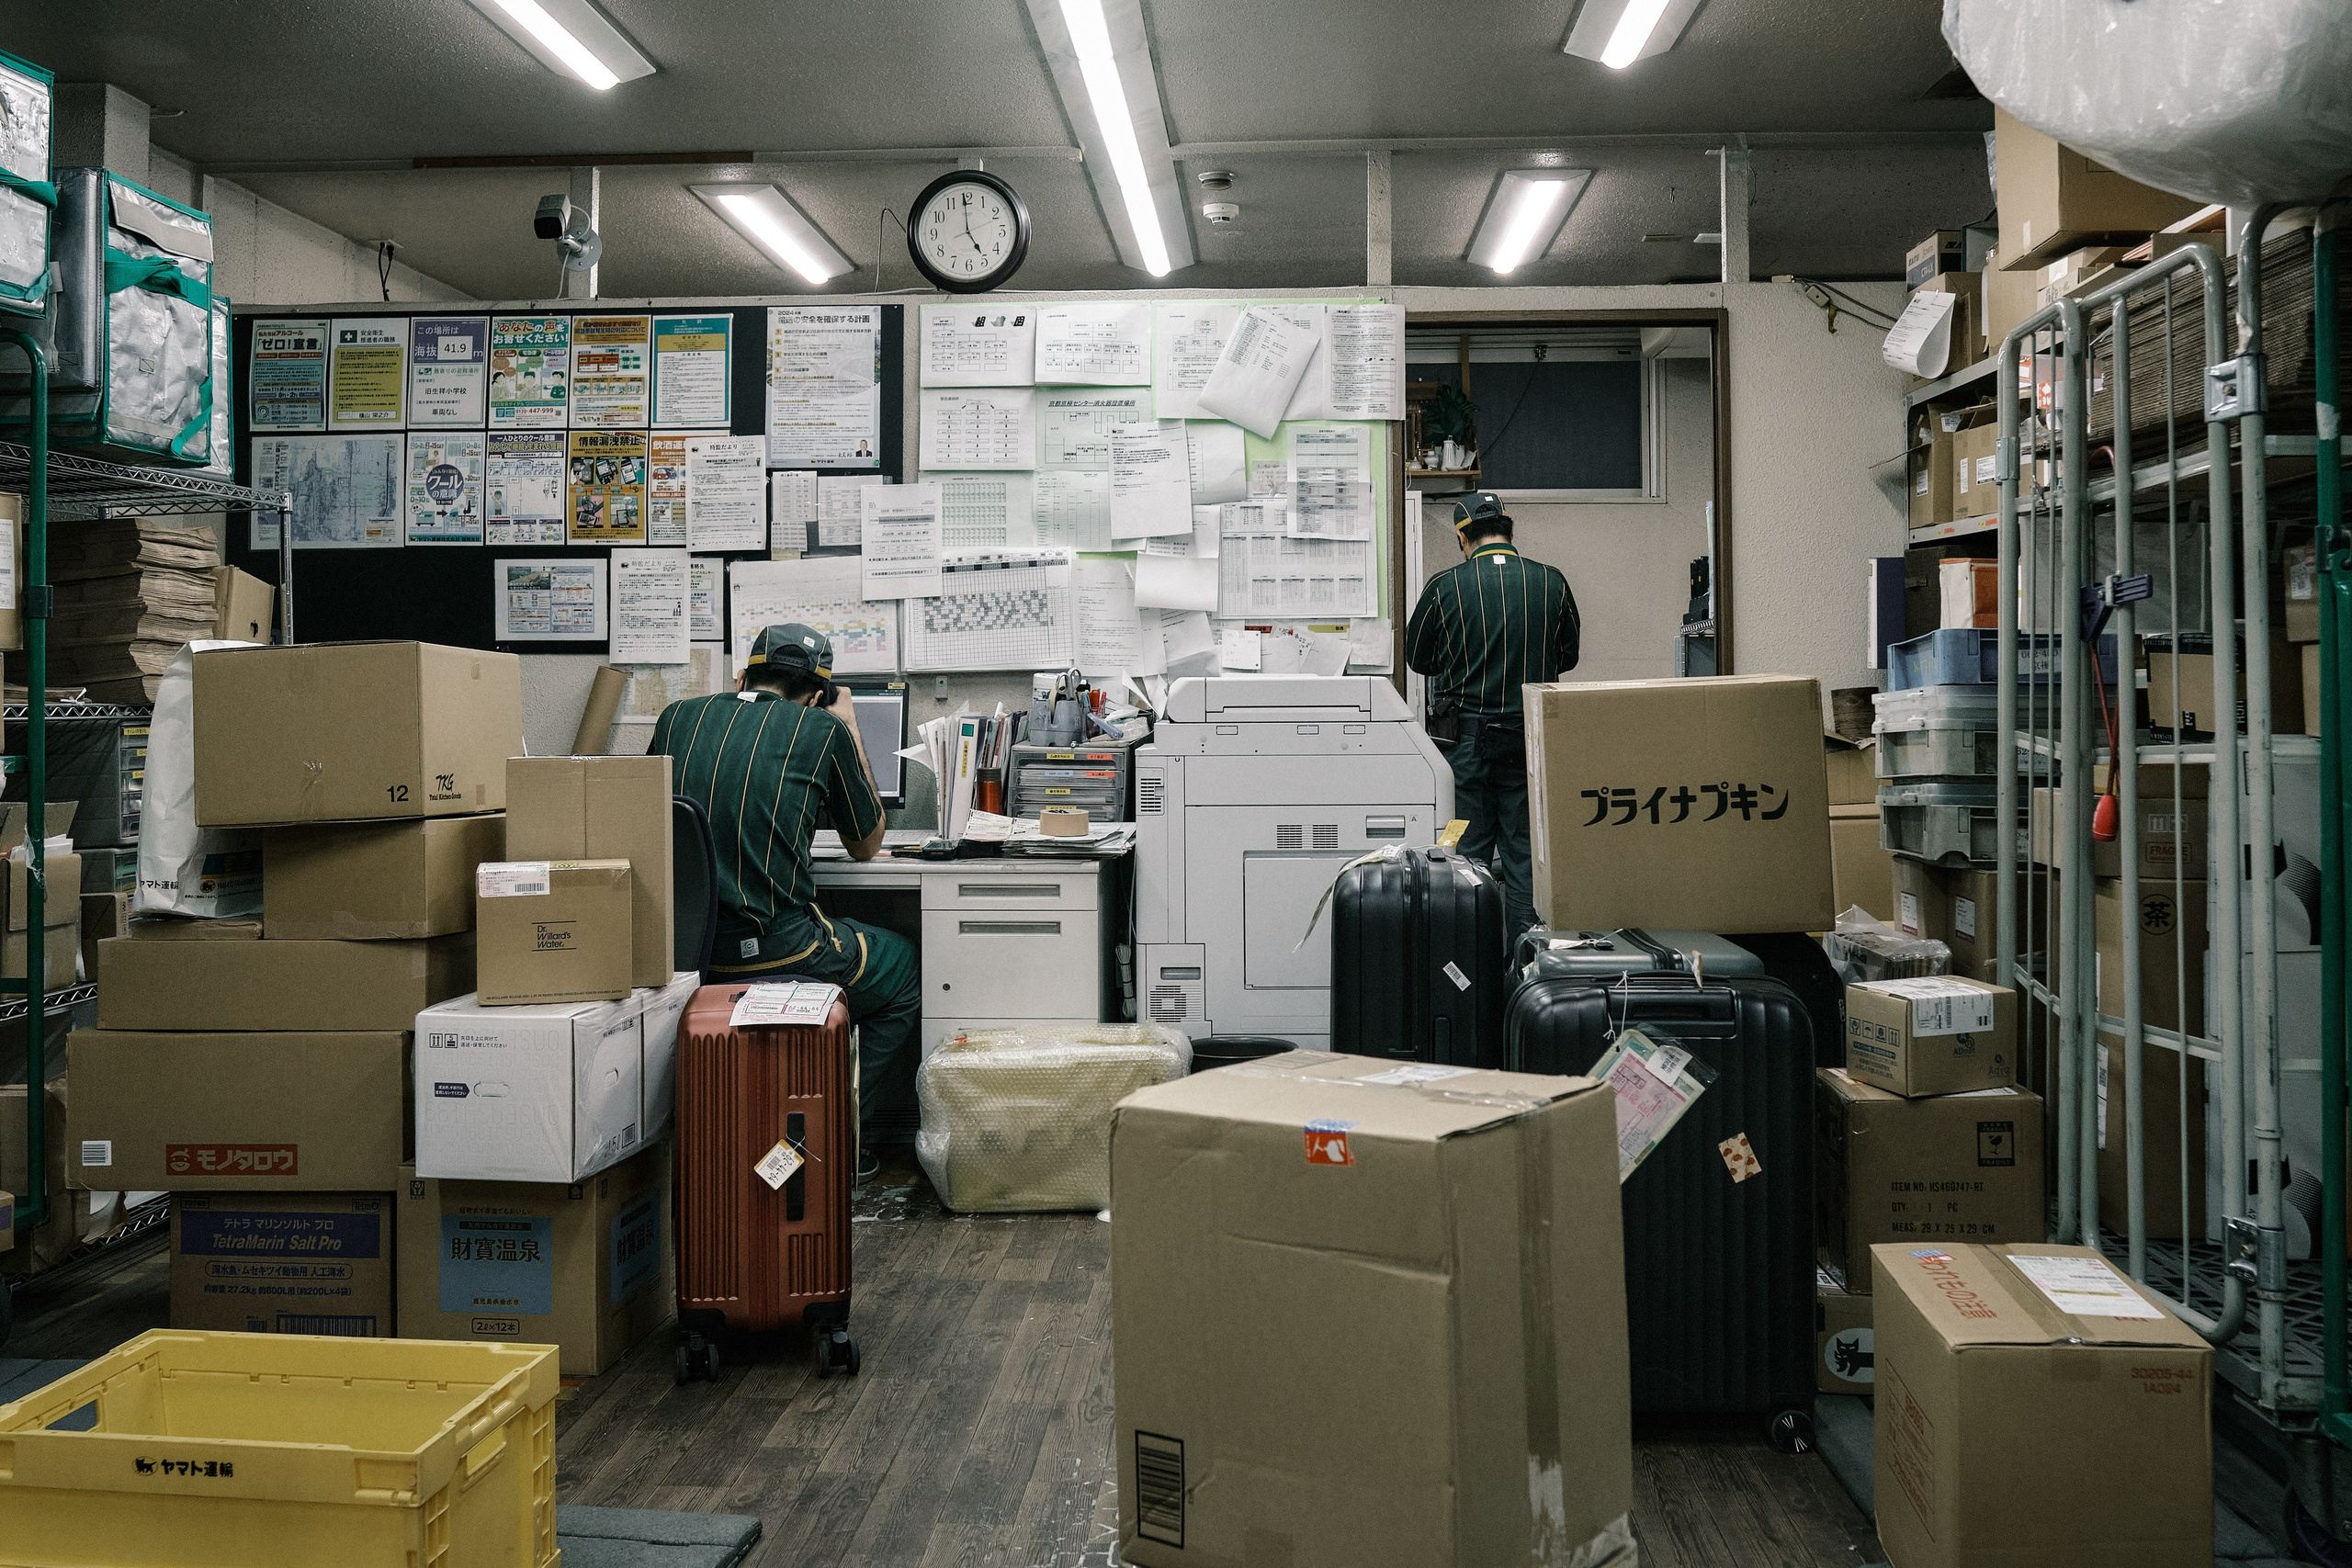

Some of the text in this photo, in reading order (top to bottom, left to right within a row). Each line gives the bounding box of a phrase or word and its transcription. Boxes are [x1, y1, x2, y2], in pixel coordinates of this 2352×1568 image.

[946, 197, 956, 209] 11
[934, 210, 945, 223] 10
[992, 207, 1000, 220] 2
[930, 228, 938, 241] 9
[999, 225, 1006, 238] 3
[937, 244, 944, 257] 8
[992, 242, 1000, 254] 4
[951, 256, 957, 268] 7
[965, 259, 973, 272] 6
[980, 254, 989, 267] 5
[417, 326, 459, 335] この場所は
[499, 321, 565, 333] あなたの声を
[414, 345, 436, 357] 海抜
[444, 343, 467, 354] 41.9
[432, 408, 458, 416] 車両なし
[578, 435, 640, 447] 情報漏洩禁止
[652, 440, 685, 450] 飲酒運
[427, 474, 463, 491] クール
[387, 784, 409, 803] 12
[439, 793, 451, 801] Kitchen
[451, 792, 462, 800] Goods
[1580, 781, 1789, 827] プライナプキン
[2150, 846, 2188, 856] FRAGE
[2143, 901, 2172, 929] 茶
[537, 924, 548, 933] Dr.
[537, 931, 571, 941] Willard's
[197, 1149, 294, 1171] モノタロウ
[1892, 1181, 1911, 1192] ITEM
[1892, 1202, 1908, 1213] QTY:
[1947, 1202, 1958, 1213] PC
[224, 1218, 334, 1231] テトラ マリンソルト プロ
[1983, 1224, 1996, 1234] CM
[211, 1233, 343, 1251] TetraMarin Salt Pro
[450, 1237, 541, 1263] 財寶温泉
[211, 1263, 345, 1278] 海水魚・ムセキツイ動物用 人工海水
[228, 1286, 257, 1295] 27.2kg
[161, 1459, 233, 1478] ヤマト運輸
